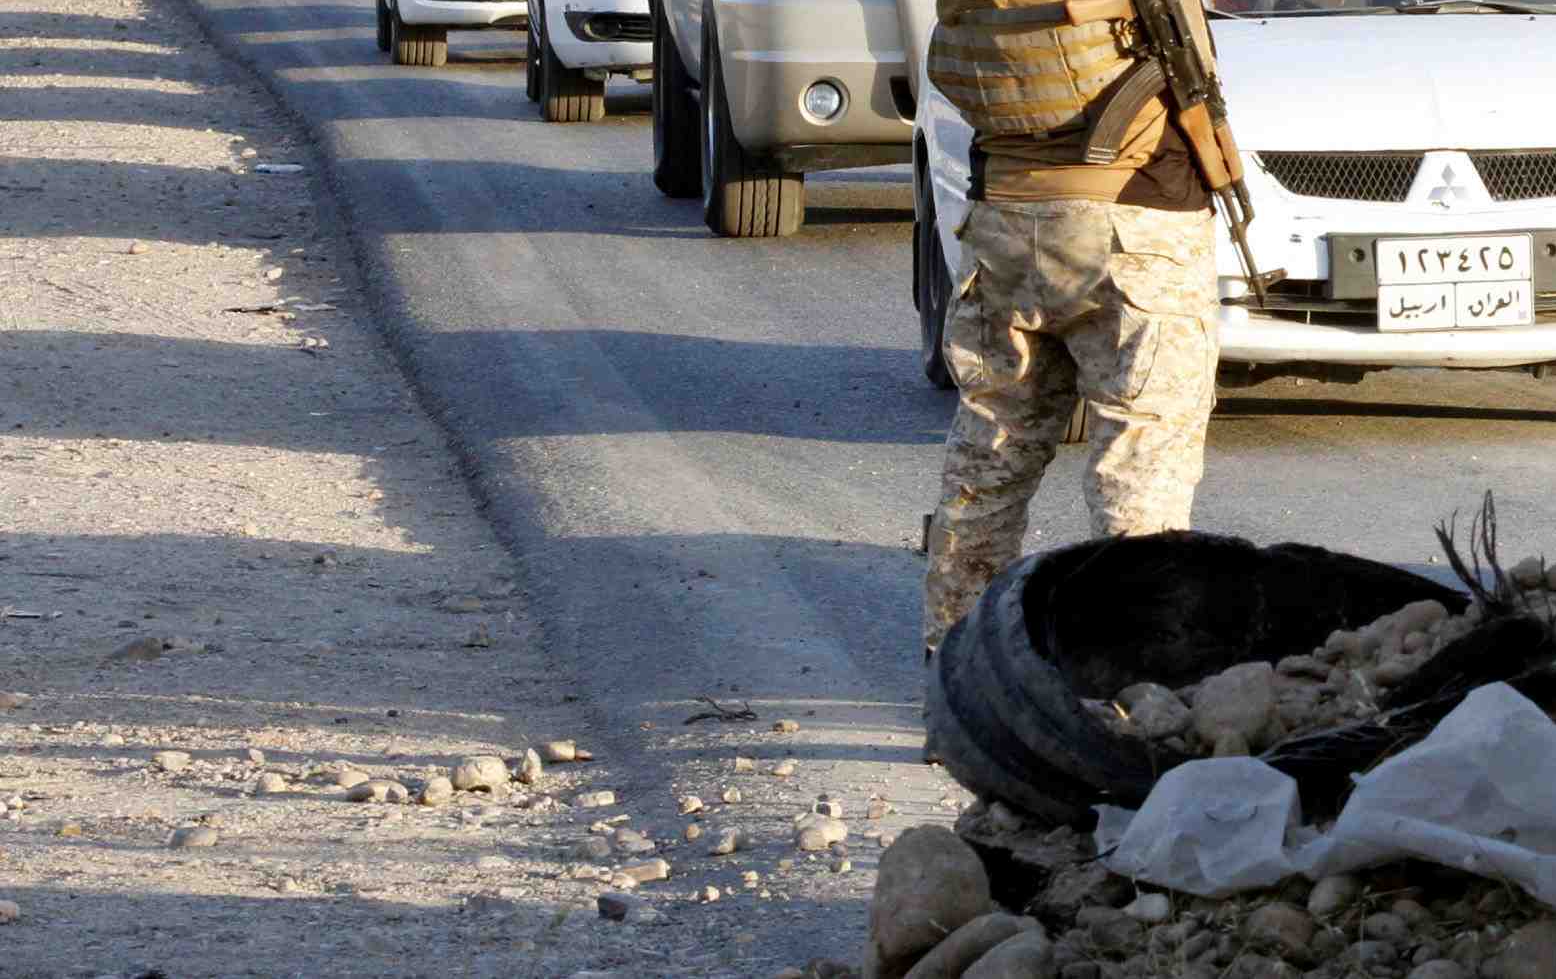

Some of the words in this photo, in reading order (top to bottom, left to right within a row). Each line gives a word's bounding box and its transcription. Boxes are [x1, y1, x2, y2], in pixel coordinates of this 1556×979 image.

[1397, 245, 1515, 275] ١٢٣٤٢٥
[1389, 294, 1447, 319] اربيل
[1467, 289, 1521, 319] العراق
